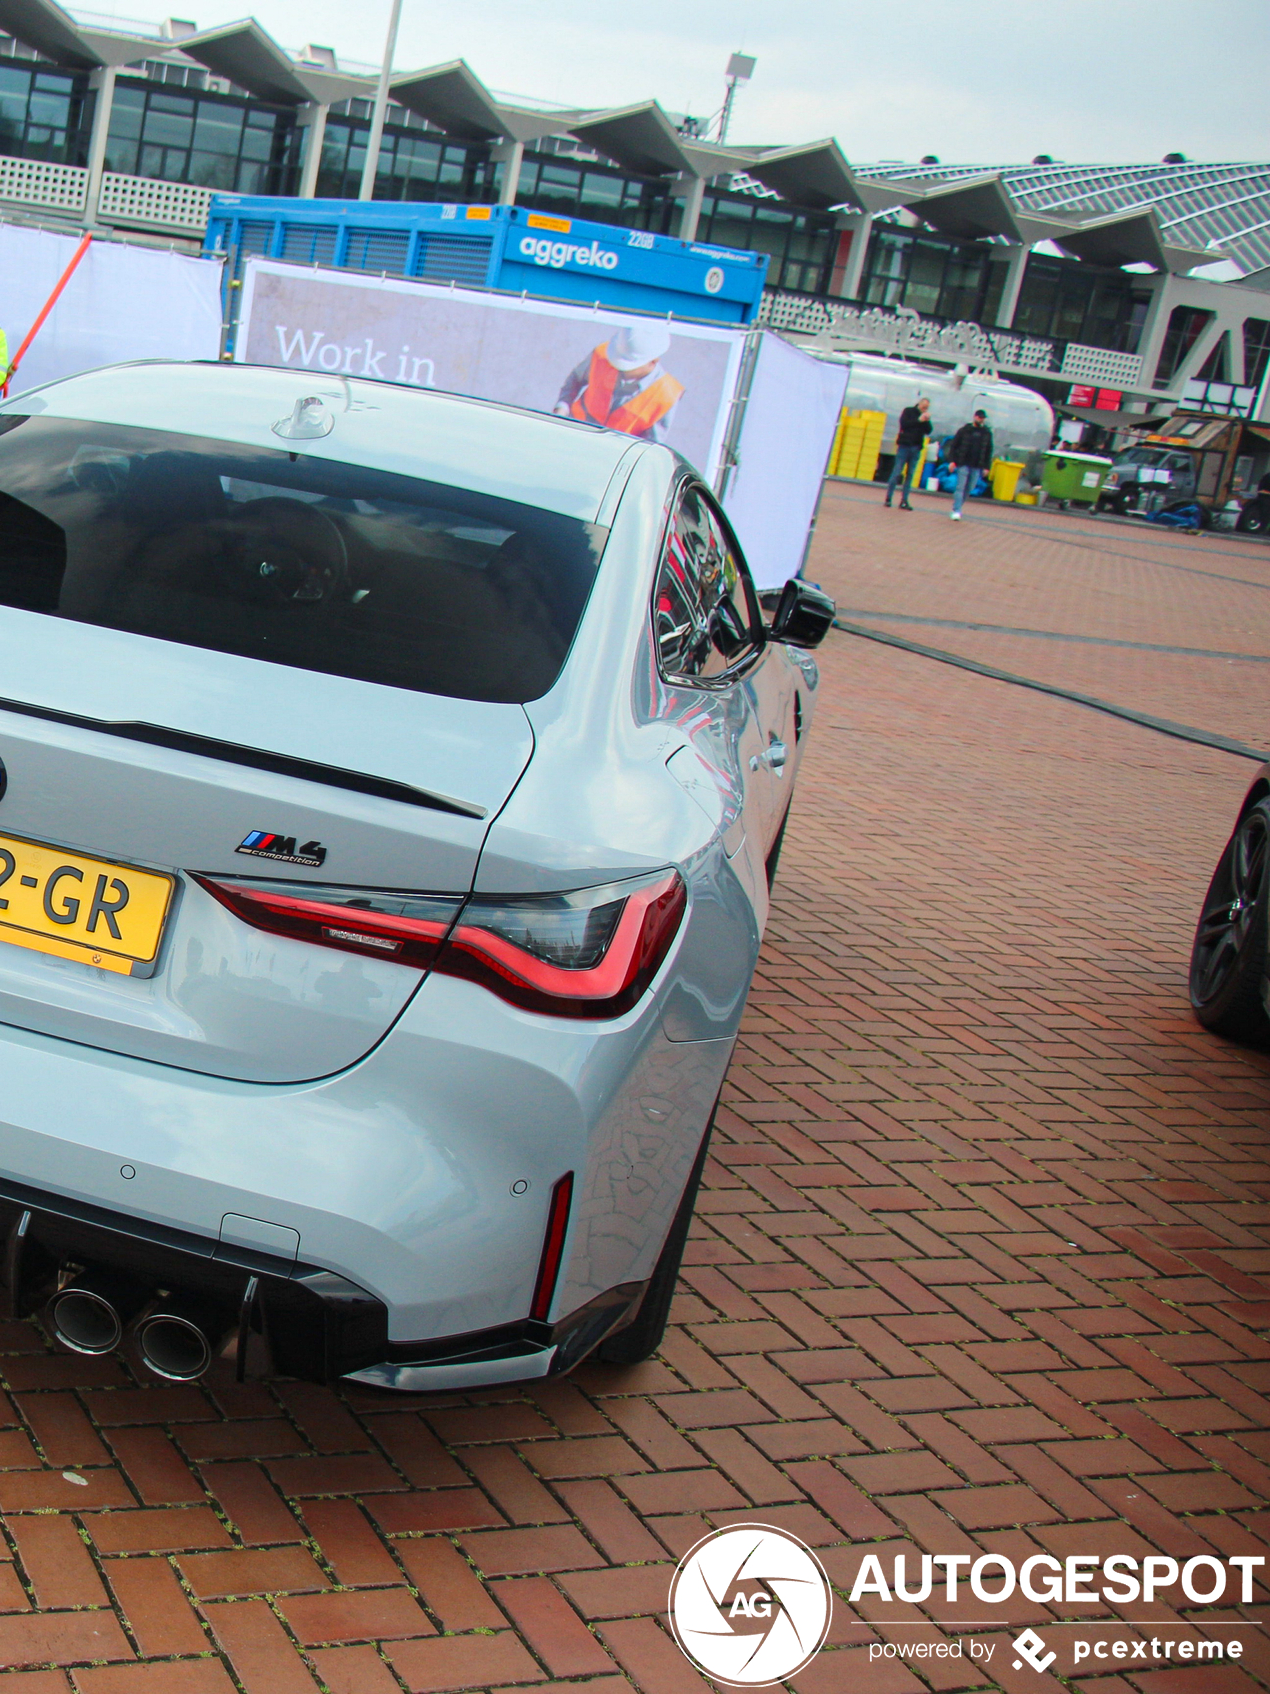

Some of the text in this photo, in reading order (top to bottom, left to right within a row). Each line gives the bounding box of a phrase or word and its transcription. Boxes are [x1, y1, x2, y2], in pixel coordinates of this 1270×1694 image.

[519, 237, 619, 270] aggreko
[275, 325, 435, 386] Work in
[251, 849, 320, 866] competition
